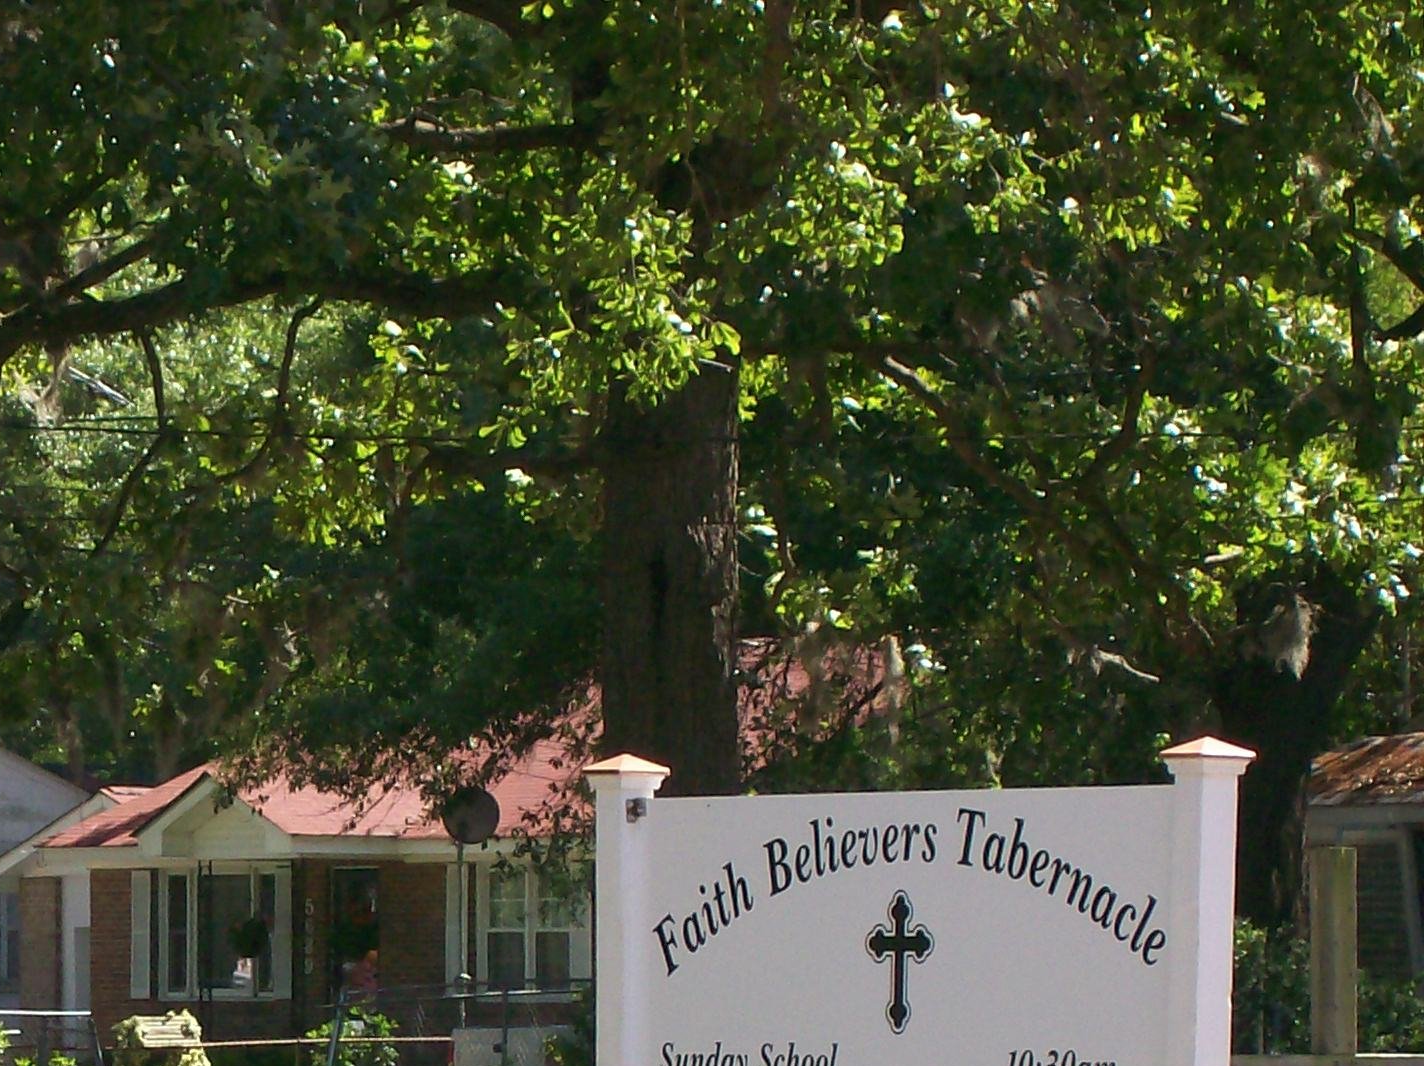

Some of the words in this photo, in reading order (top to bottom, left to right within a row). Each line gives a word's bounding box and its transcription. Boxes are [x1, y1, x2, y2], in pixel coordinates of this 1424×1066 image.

[652, 861, 754, 977] Faith
[762, 816, 938, 897] Believers
[956, 807, 1166, 966] Tabernacle
